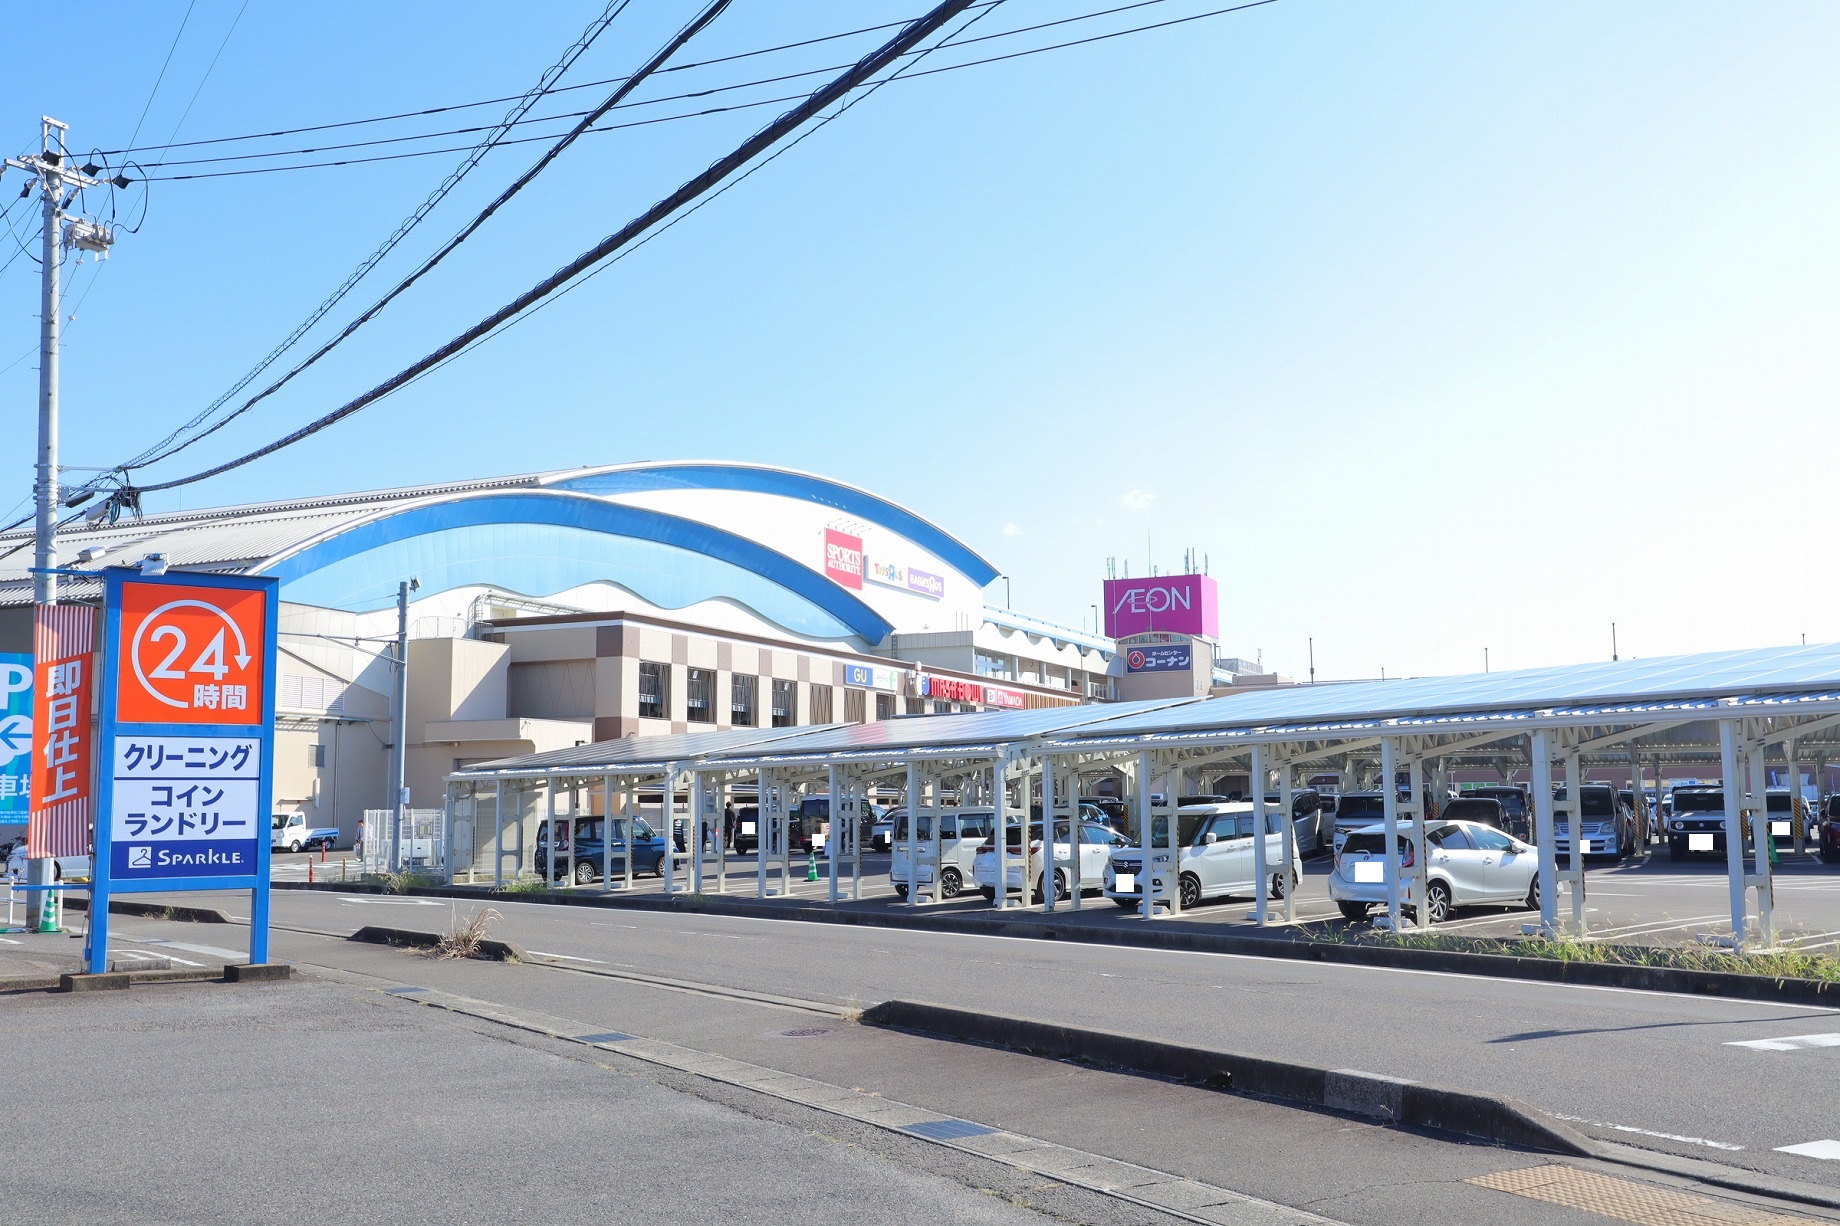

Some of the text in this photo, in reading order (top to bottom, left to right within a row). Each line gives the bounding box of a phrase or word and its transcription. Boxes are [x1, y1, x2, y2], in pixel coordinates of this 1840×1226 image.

[827, 543, 861, 567] SPORTS
[827, 558, 862, 576] AUTHORITY
[148, 625, 230, 681] 24
[1145, 656, 1190, 667] コーナン
[0, 663, 34, 710] P
[854, 668, 867, 684] GU
[193, 684, 247, 711] 時間
[42, 660, 82, 804] 即日仕上
[124, 743, 253, 771] クリーニング
[151, 785, 225, 808] コイン
[124, 813, 247, 837] ランドリー
